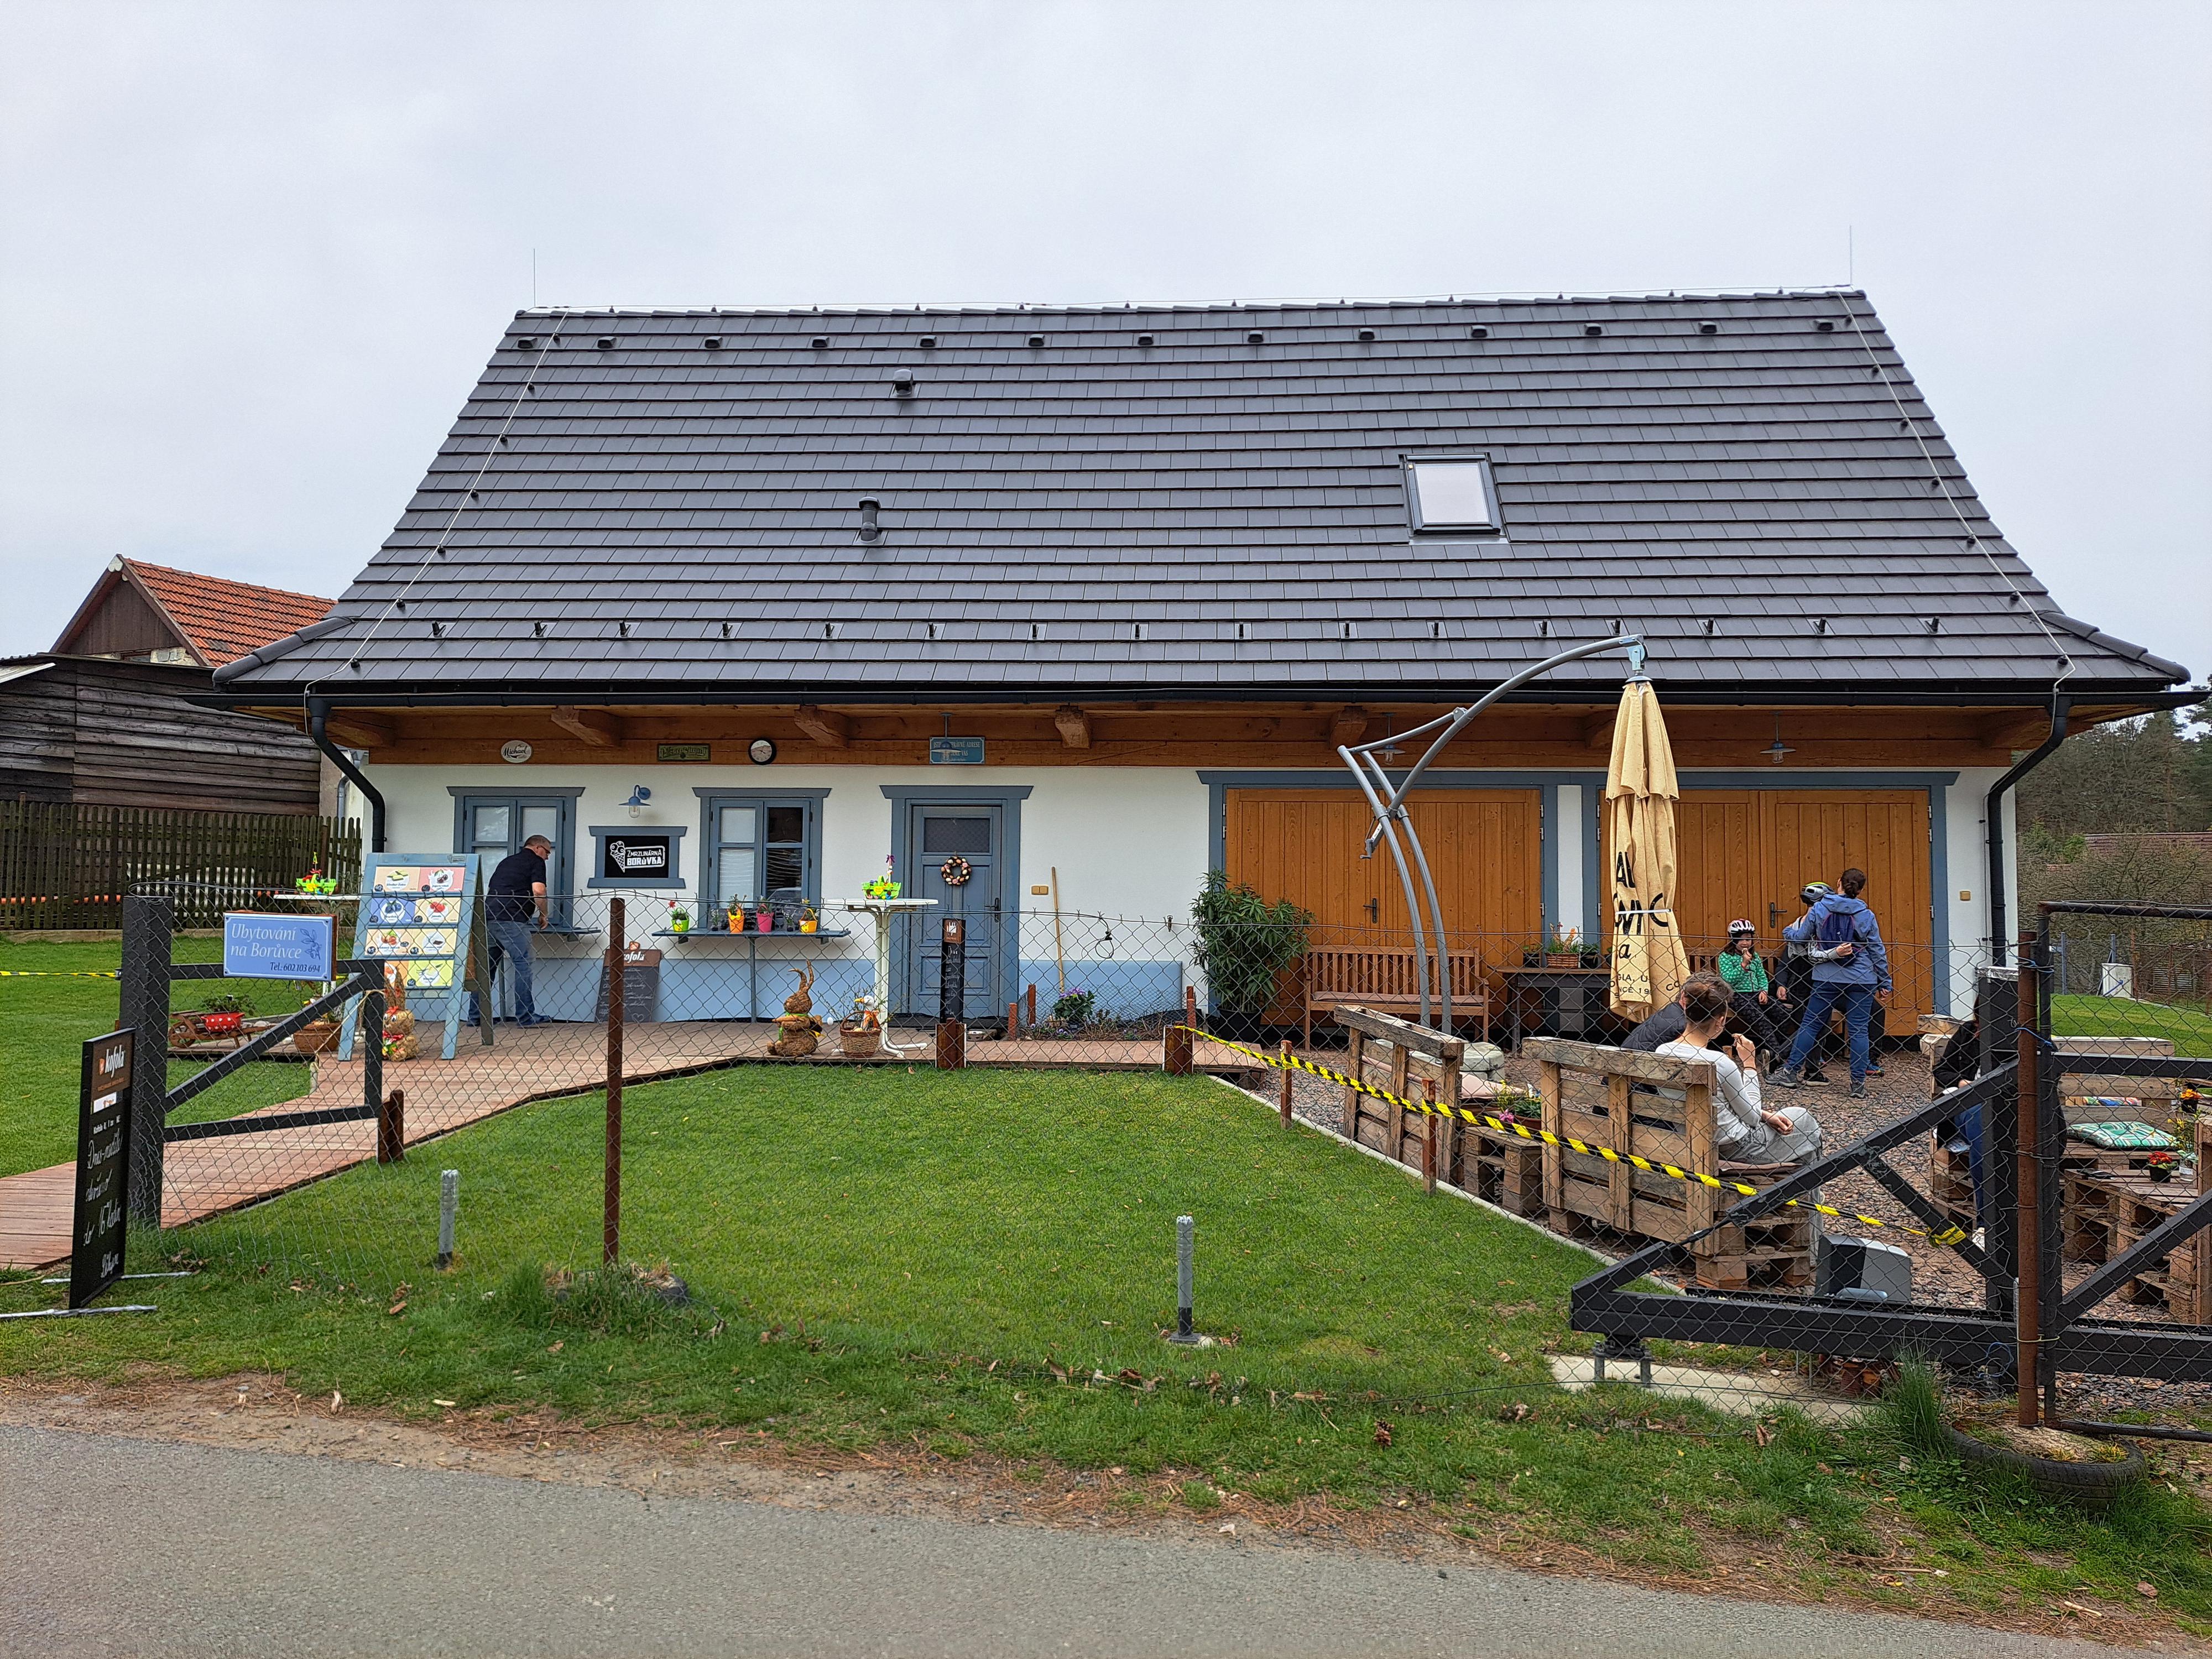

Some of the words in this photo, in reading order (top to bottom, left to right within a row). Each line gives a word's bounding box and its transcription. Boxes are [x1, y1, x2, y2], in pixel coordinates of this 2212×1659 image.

[627, 849, 662, 857] ZMRZLINÁRNA
[627, 857, 662, 866] BORŮVKA
[231, 923, 297, 942] Ubytování
[230, 945, 247, 957] na
[251, 942, 302, 959] Borůvce
[283, 963, 296, 972] 602
[296, 964, 307, 972] 103
[308, 964, 321, 973] 694
[104, 1044, 124, 1078] kofola
